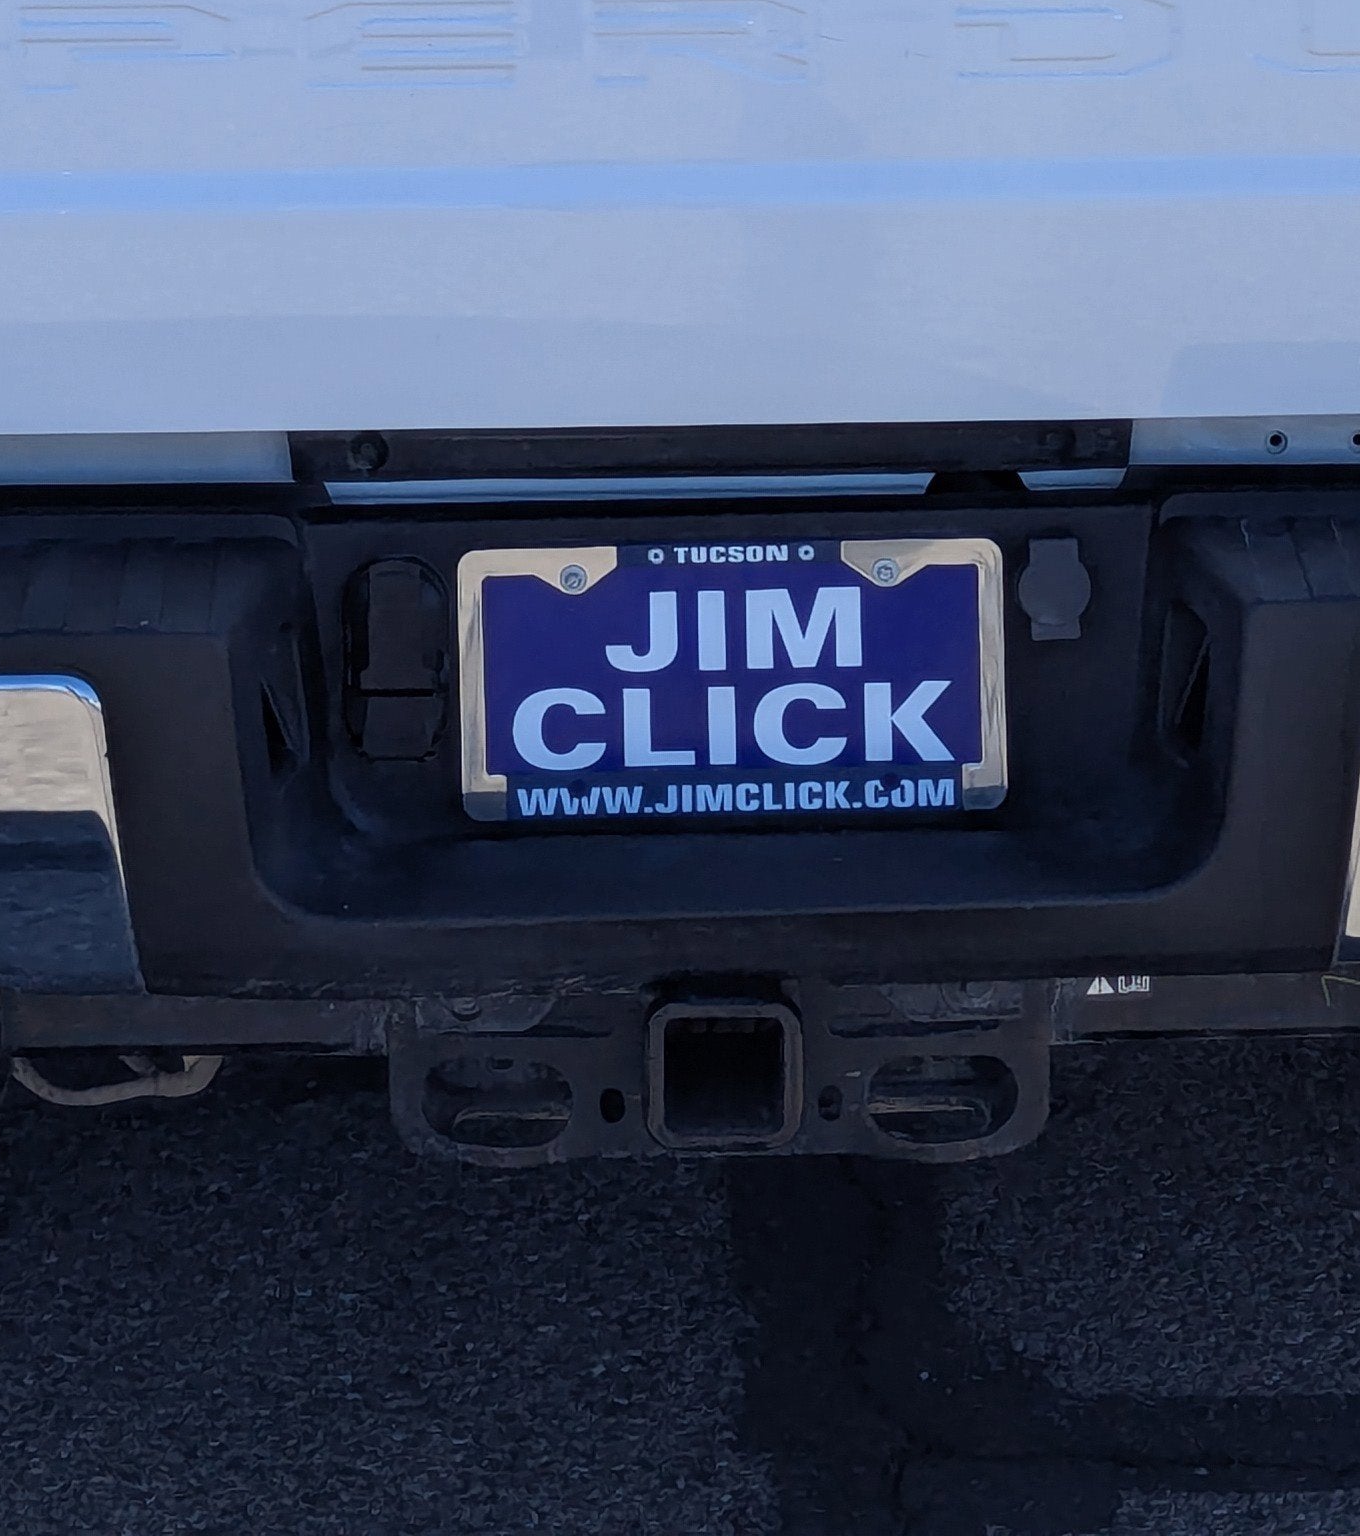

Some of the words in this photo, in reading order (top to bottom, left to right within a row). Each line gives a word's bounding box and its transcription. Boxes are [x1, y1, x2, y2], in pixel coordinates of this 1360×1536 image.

[673, 544, 789, 565] TUCSON
[605, 586, 863, 673] JIM
[512, 679, 956, 771] CLICK
[516, 778, 956, 817] WWW.JIMCLICK.COM
